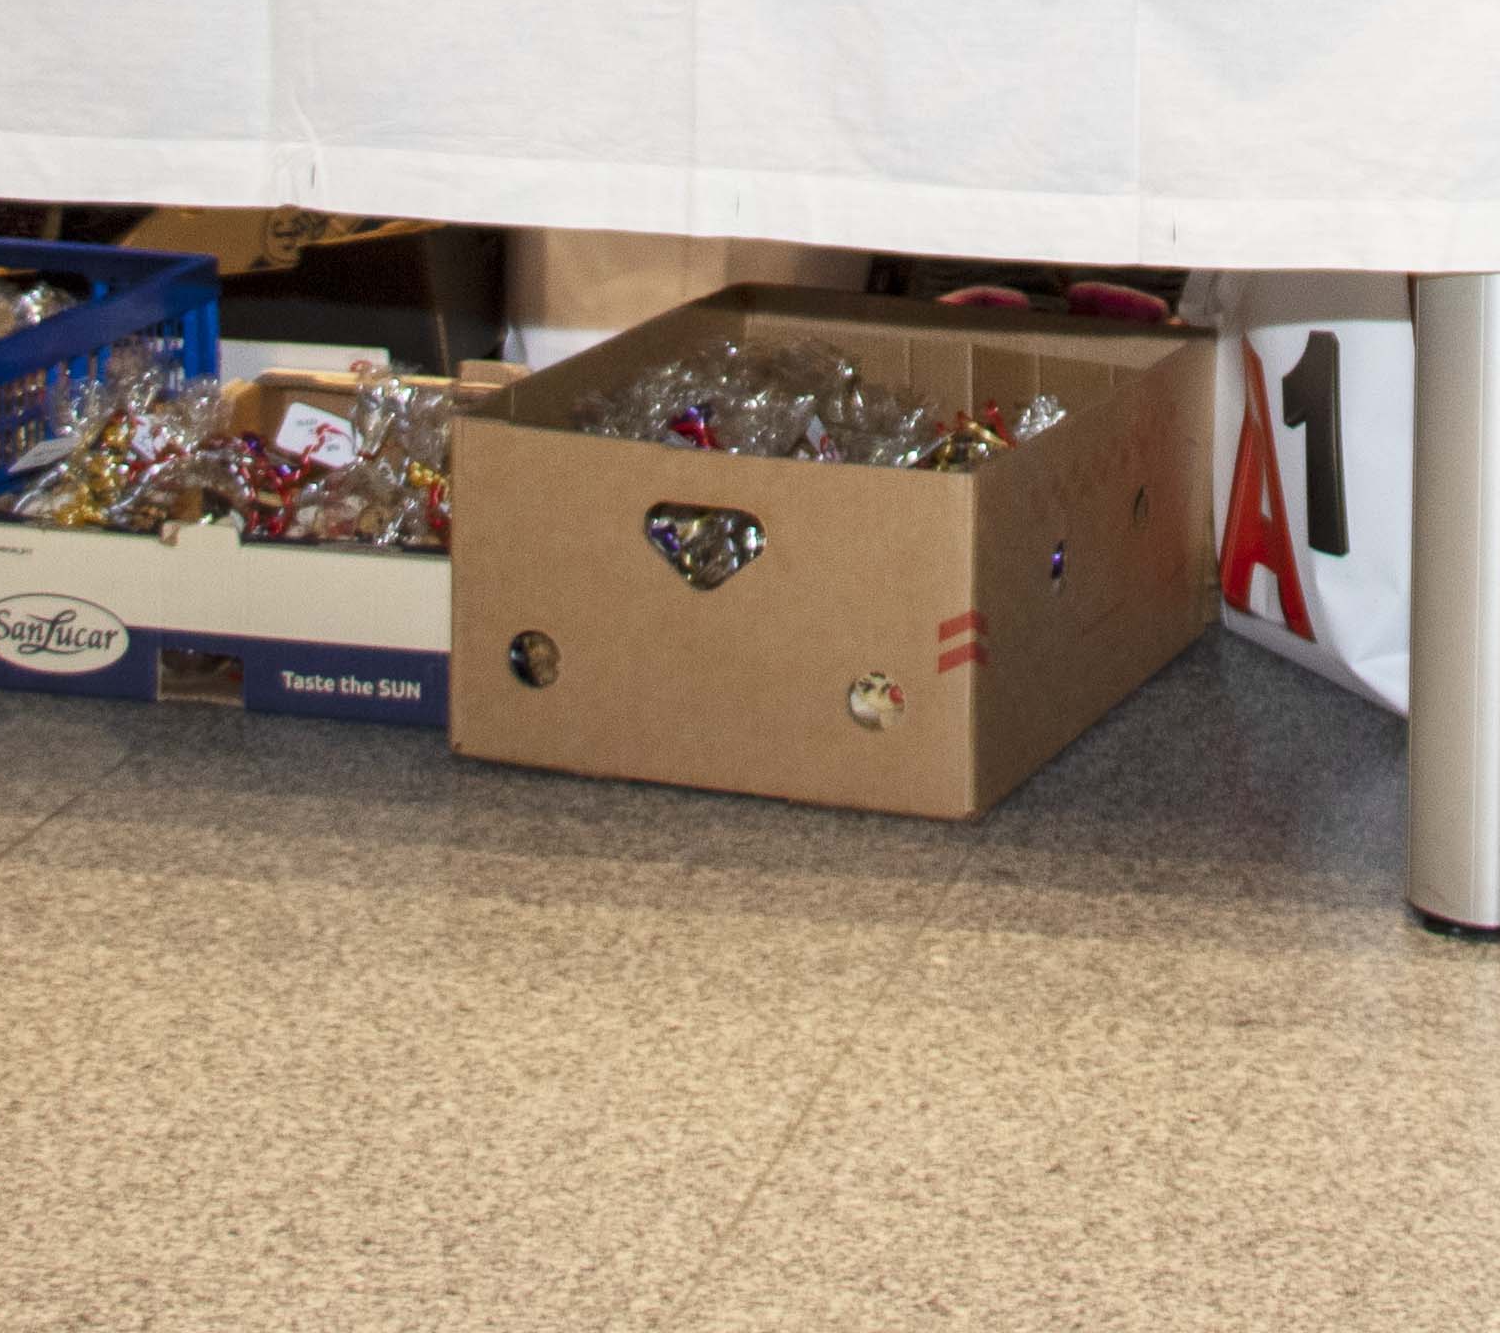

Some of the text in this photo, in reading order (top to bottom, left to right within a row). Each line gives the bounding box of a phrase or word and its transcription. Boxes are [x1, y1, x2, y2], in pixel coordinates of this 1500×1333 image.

[1219, 330, 1350, 644] A1
[282, 670, 421, 701] Taste the SUN
